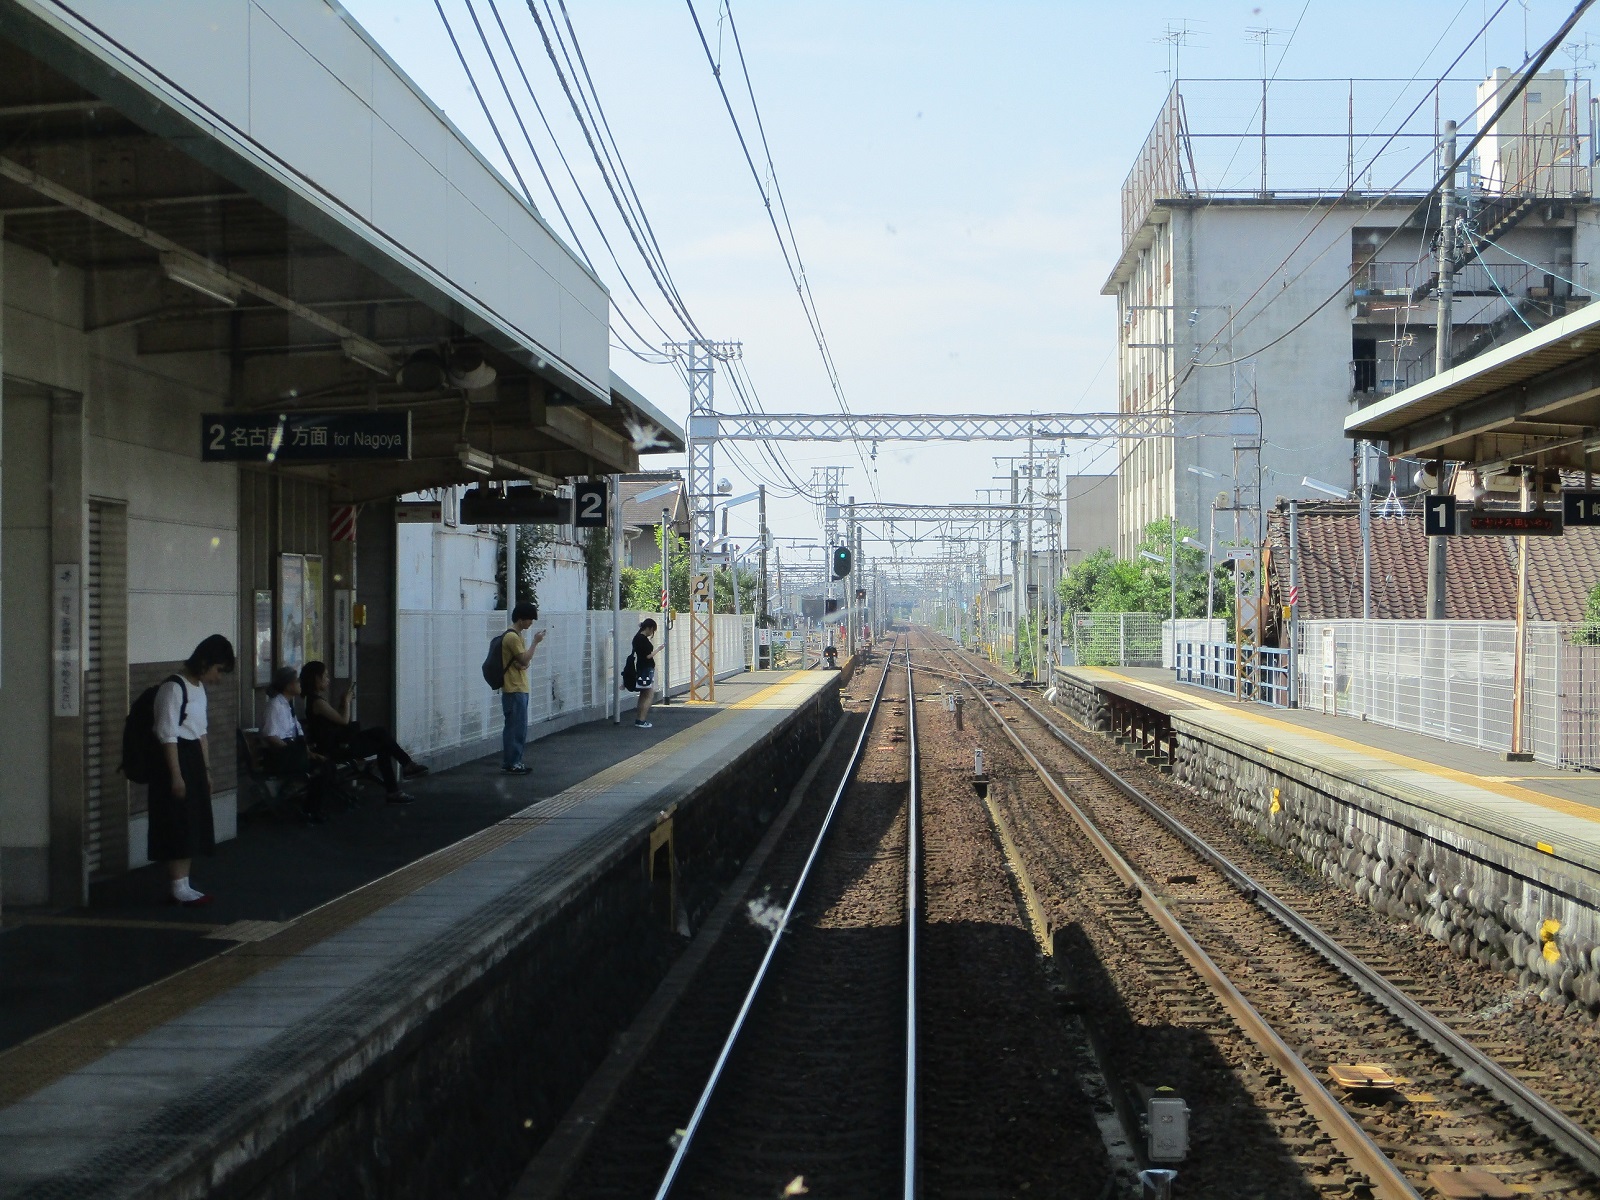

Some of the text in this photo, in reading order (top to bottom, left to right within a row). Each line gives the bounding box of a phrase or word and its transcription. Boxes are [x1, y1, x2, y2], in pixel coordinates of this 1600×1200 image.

[209, 424, 226, 450] 2
[292, 426, 328, 447] 方面
[334, 432, 350, 446] for
[354, 432, 402, 449] Nagoya
[580, 492, 603, 518] 2
[1432, 503, 1447, 528] 1
[1576, 499, 1585, 519] 1
